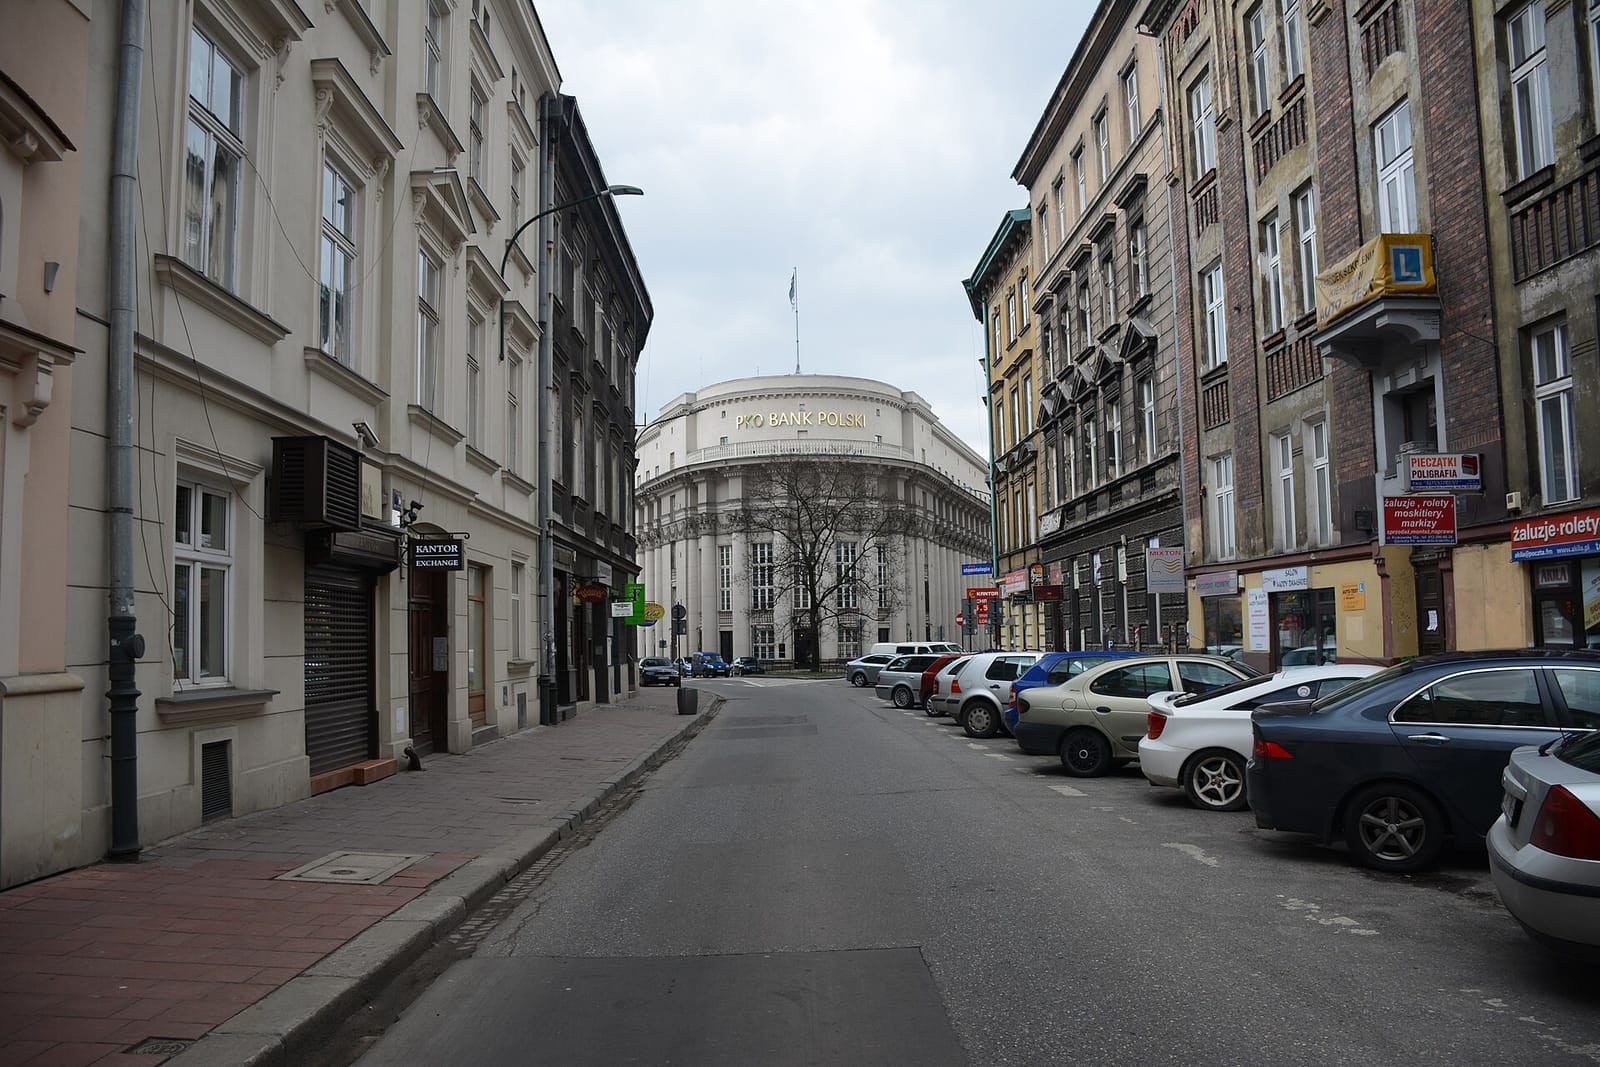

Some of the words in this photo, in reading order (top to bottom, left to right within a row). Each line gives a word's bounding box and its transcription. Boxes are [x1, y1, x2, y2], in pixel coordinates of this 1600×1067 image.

[1399, 253, 1417, 278] L
[736, 414, 764, 431] PKO
[769, 410, 813, 428] BANK
[818, 411, 866, 428] POLSKI
[1411, 457, 1457, 469] PIECZĄTKI
[1412, 470, 1457, 479] POLIGRAFIA
[1394, 509, 1444, 518] moskitiery,
[1401, 519, 1437, 529] markizy
[416, 544, 458, 553] KANTOR
[415, 559, 459, 567] EXCHANGE
[1540, 567, 1567, 583] AKILA
